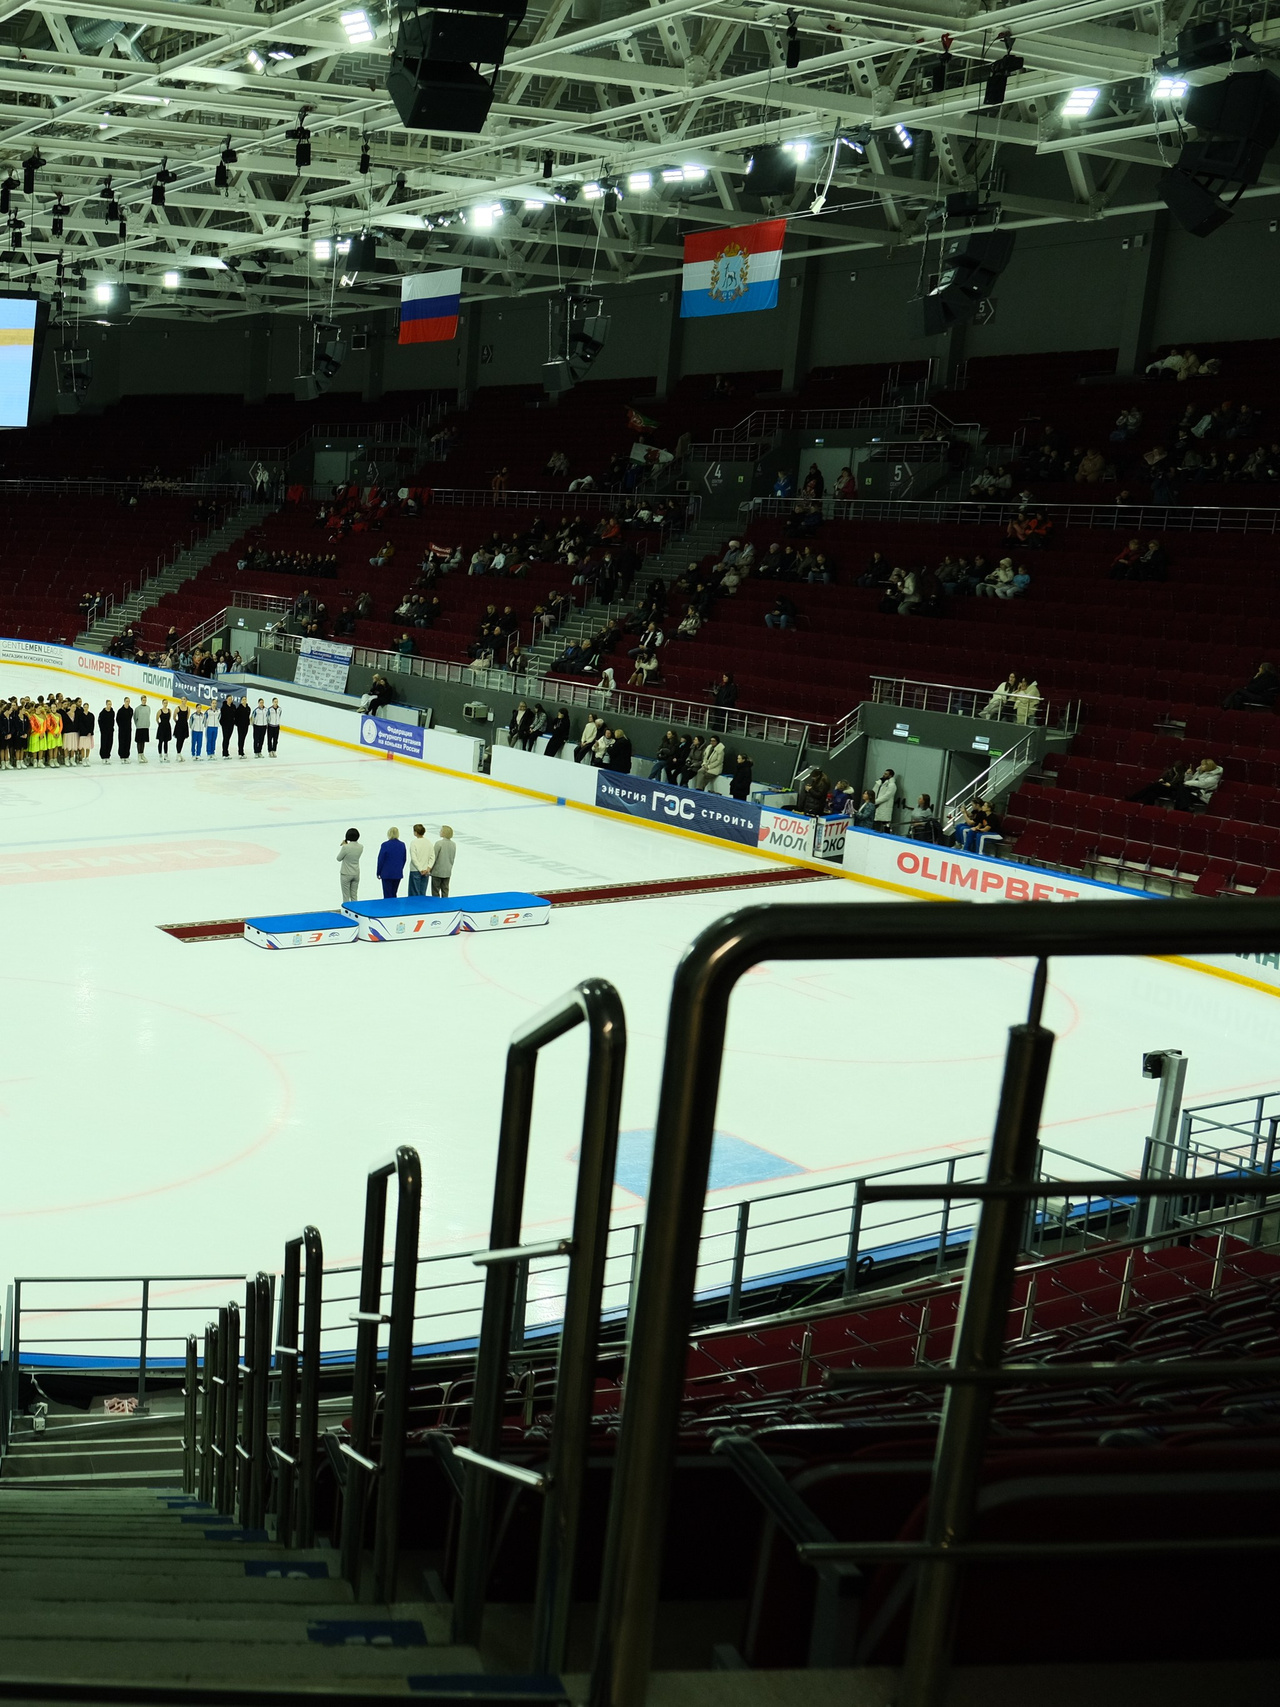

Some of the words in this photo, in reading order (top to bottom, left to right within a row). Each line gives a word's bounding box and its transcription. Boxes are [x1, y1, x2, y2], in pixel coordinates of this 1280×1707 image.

[714, 463, 722, 479] 4
[893, 464, 902, 481] 5
[2, 640, 43, 652] GENTLEMEN
[44, 647, 63, 656] LEAGUE
[78, 656, 122, 676] OLIMPBET
[198, 683, 219, 700] ГЭС
[378, 731, 402, 742] фигурного
[402, 737, 422, 746] катания
[387, 725, 413, 737] Федерация
[385, 740, 402, 749] коньках
[403, 743, 420, 753] России
[601, 785, 646, 803] ЭНЕРГИЯ
[652, 791, 696, 820] ГЭС
[701, 809, 754, 829] СТРОИТЬ
[413, 919, 425, 933] 1
[503, 913, 522, 925] 2
[307, 932, 324, 943] 3
